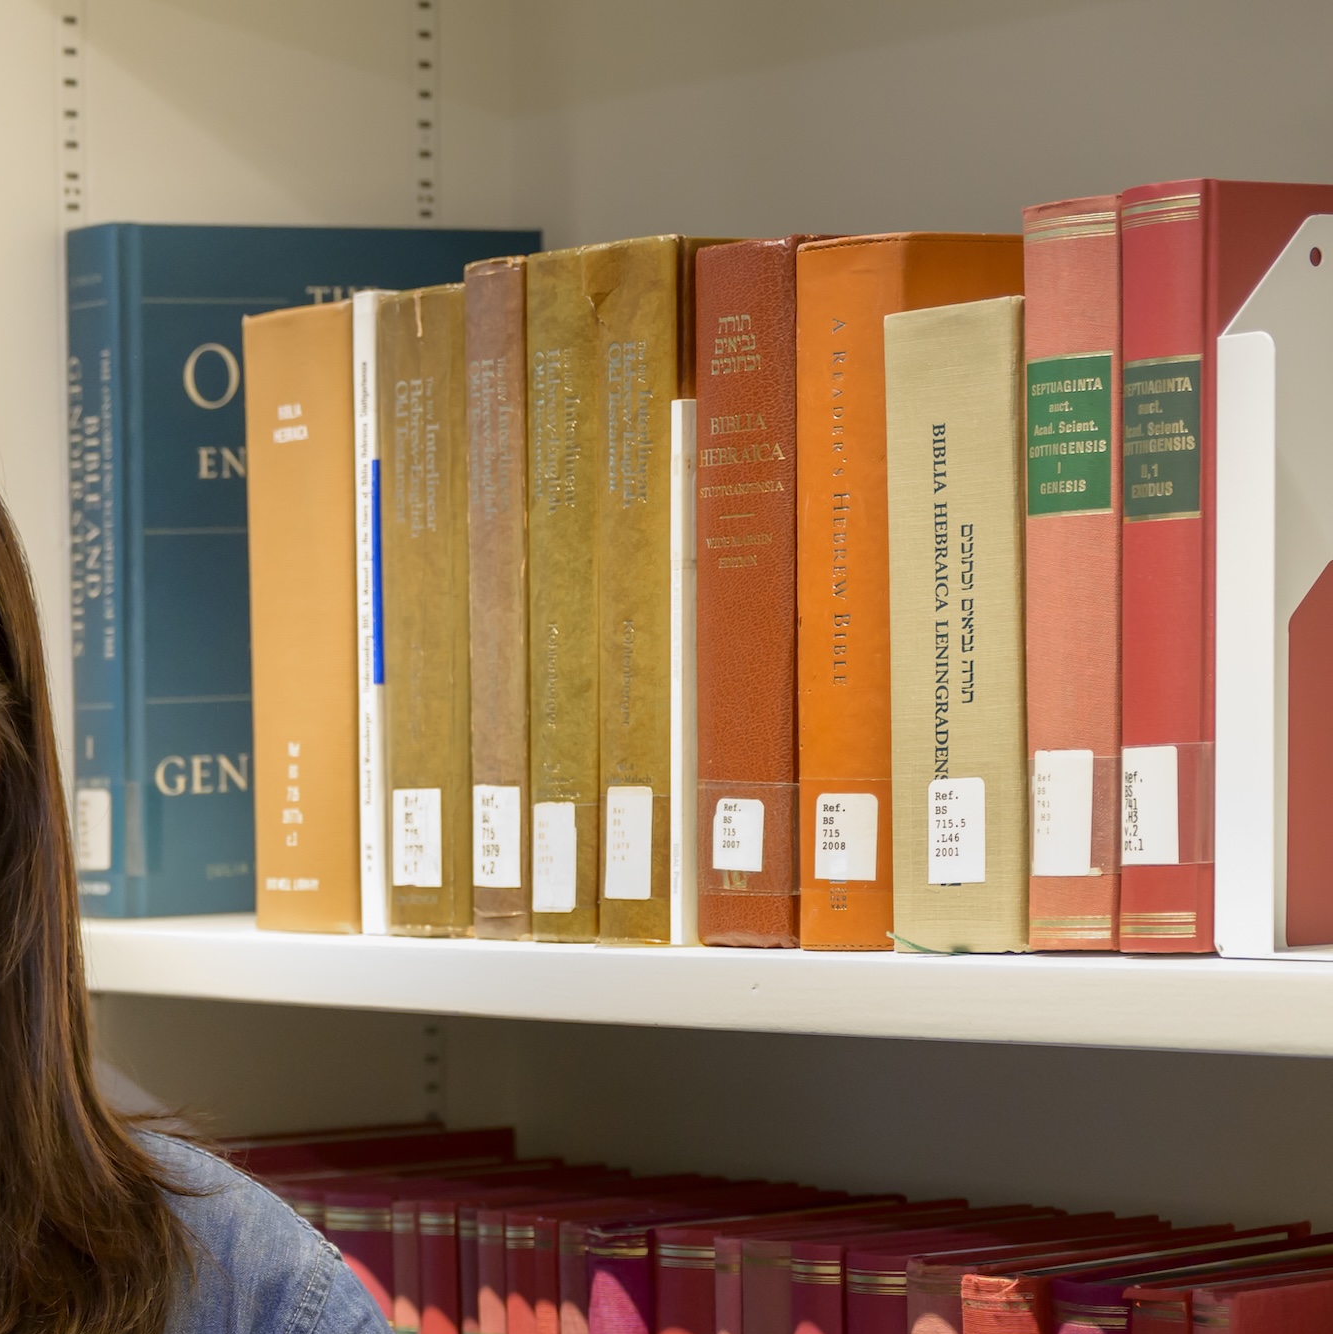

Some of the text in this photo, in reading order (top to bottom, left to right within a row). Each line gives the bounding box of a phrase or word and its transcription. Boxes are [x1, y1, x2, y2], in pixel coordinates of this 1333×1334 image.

[718, 314, 752, 334] תורה
[831, 317, 847, 335] A
[714, 334, 756, 355] נביאים
[533, 351, 545, 390] Old
[710, 354, 762, 376] וכתובים
[638, 364, 647, 385] NIV
[1031, 377, 1103, 396] SEPTUAGINTA
[395, 379, 409, 418] Old
[1049, 400, 1073, 413] auct.
[1137, 400, 1163, 415] auct.
[607, 341, 622, 495] Old Testament
[621, 340, 637, 511] Hebrew-English
[710, 413, 767, 436] BIBLIA
[545, 348, 561, 516] Hebrew-English
[1034, 420, 1098, 437] Acad. Scient.
[1147, 420, 1189, 436] Scient.
[637, 388, 653, 504] Interlinear
[1029, 439, 1107, 459] GOTTINGENSIS
[699, 443, 786, 468] HEBRAICA
[931, 423, 948, 494] BIBLIA
[426, 421, 441, 532] Interlinear
[699, 481, 785, 500] STUTTGARTENSIA
[1040, 479, 1086, 495] GENESIS
[1131, 481, 1173, 499] EXODUS
[83, 415, 102, 598] BIBLE AND
[706, 536, 730, 550] WIDE
[831, 492, 851, 602] HEBREW
[718, 554, 758, 569] EDITION
[932, 501, 949, 612] HEBRAICA
[960, 523, 975, 704] תורה נביאים וכתובים
[832, 612, 851, 688] BIBLE
[545, 623, 559, 729] Kohlenberger
[620, 620, 634, 727] Kohlenberger
[1124, 772, 1144, 784] Ref.
[935, 791, 959, 801] Ref.
[1124, 786, 1133, 797] BS
[723, 803, 742, 812] Ref.
[823, 803, 847, 813] Ref.
[935, 806, 948, 815] BS
[1124, 798, 1138, 811] 741
[723, 816, 732, 824] BS
[822, 816, 835, 825] BS
[935, 819, 966, 829] 715.5
[482, 828, 495, 840] 715
[723, 828, 736, 837] 715
[822, 829, 840, 838] 715
[935, 834, 960, 843] .L46
[1124, 825, 1139, 837] v.2
[482, 844, 500, 857] 1979
[722, 840, 740, 849] 2007
[822, 841, 846, 850] 2008
[935, 847, 960, 857] 2001
[1124, 839, 1144, 852] pt.1
